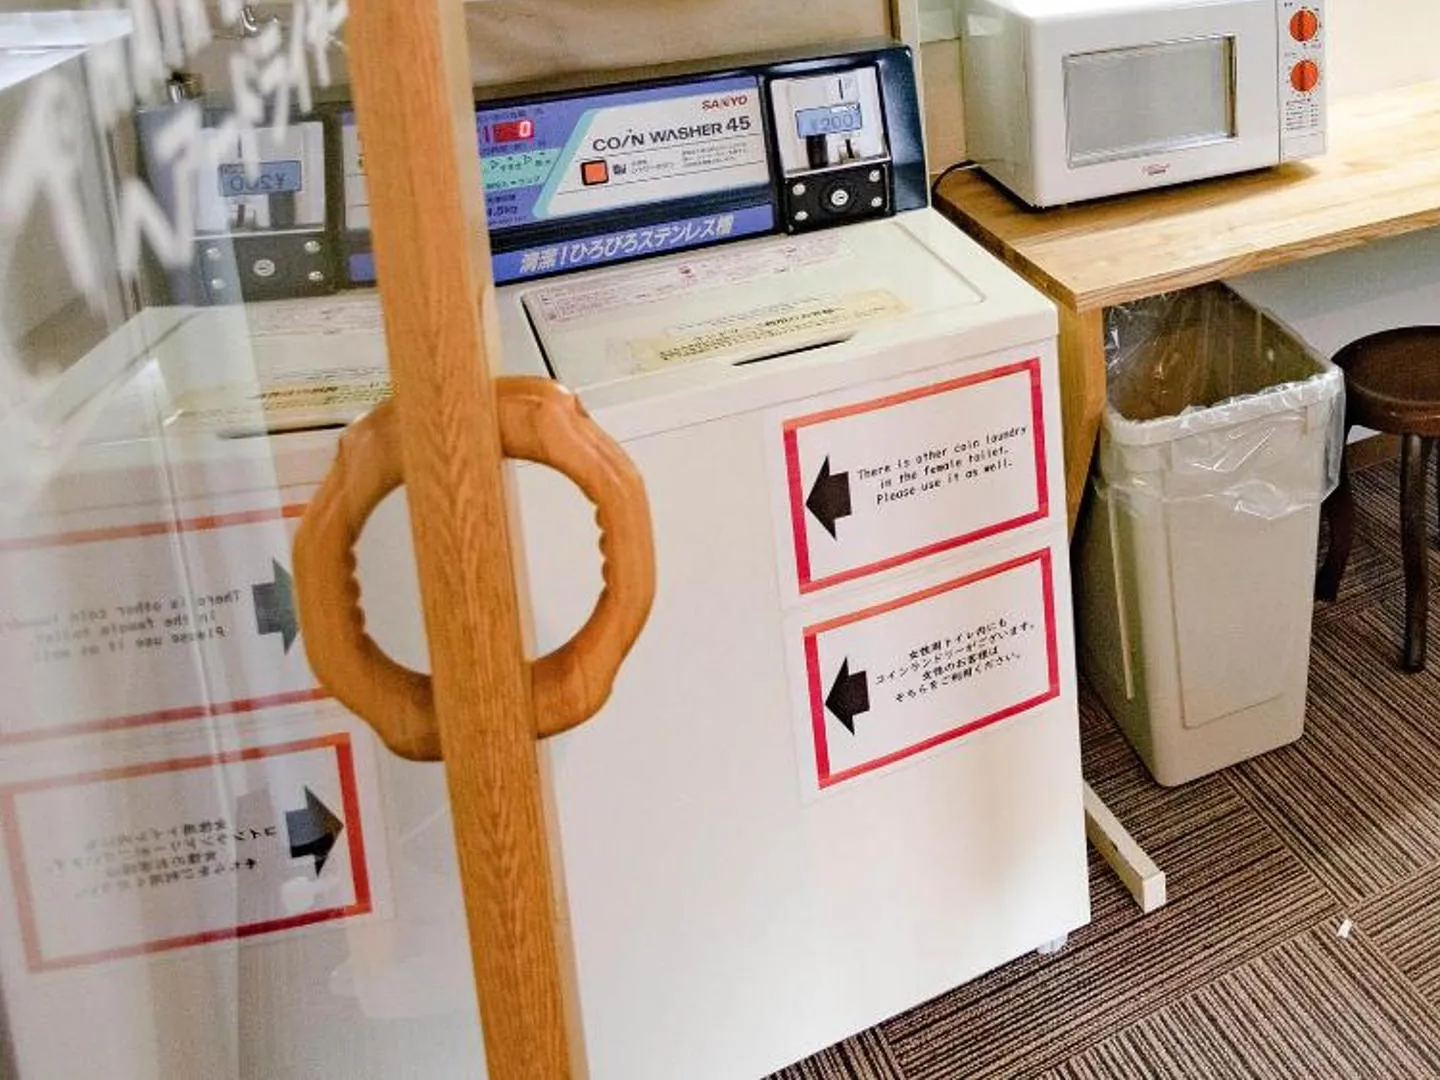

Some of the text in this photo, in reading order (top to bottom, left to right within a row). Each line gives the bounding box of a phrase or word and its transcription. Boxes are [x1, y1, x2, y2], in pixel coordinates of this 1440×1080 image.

[702, 95, 748, 111] SANYO
[650, 123, 723, 144] WASHER
[726, 116, 752, 131] 45
[857, 425, 1027, 480] There is other coin laundry
[876, 487, 915, 505] Please
[921, 479, 941, 492] use
[947, 473, 959, 484] it
[965, 469, 979, 479] as
[880, 479, 892, 489] in
[899, 470, 918, 484] the
[923, 459, 962, 476] female
